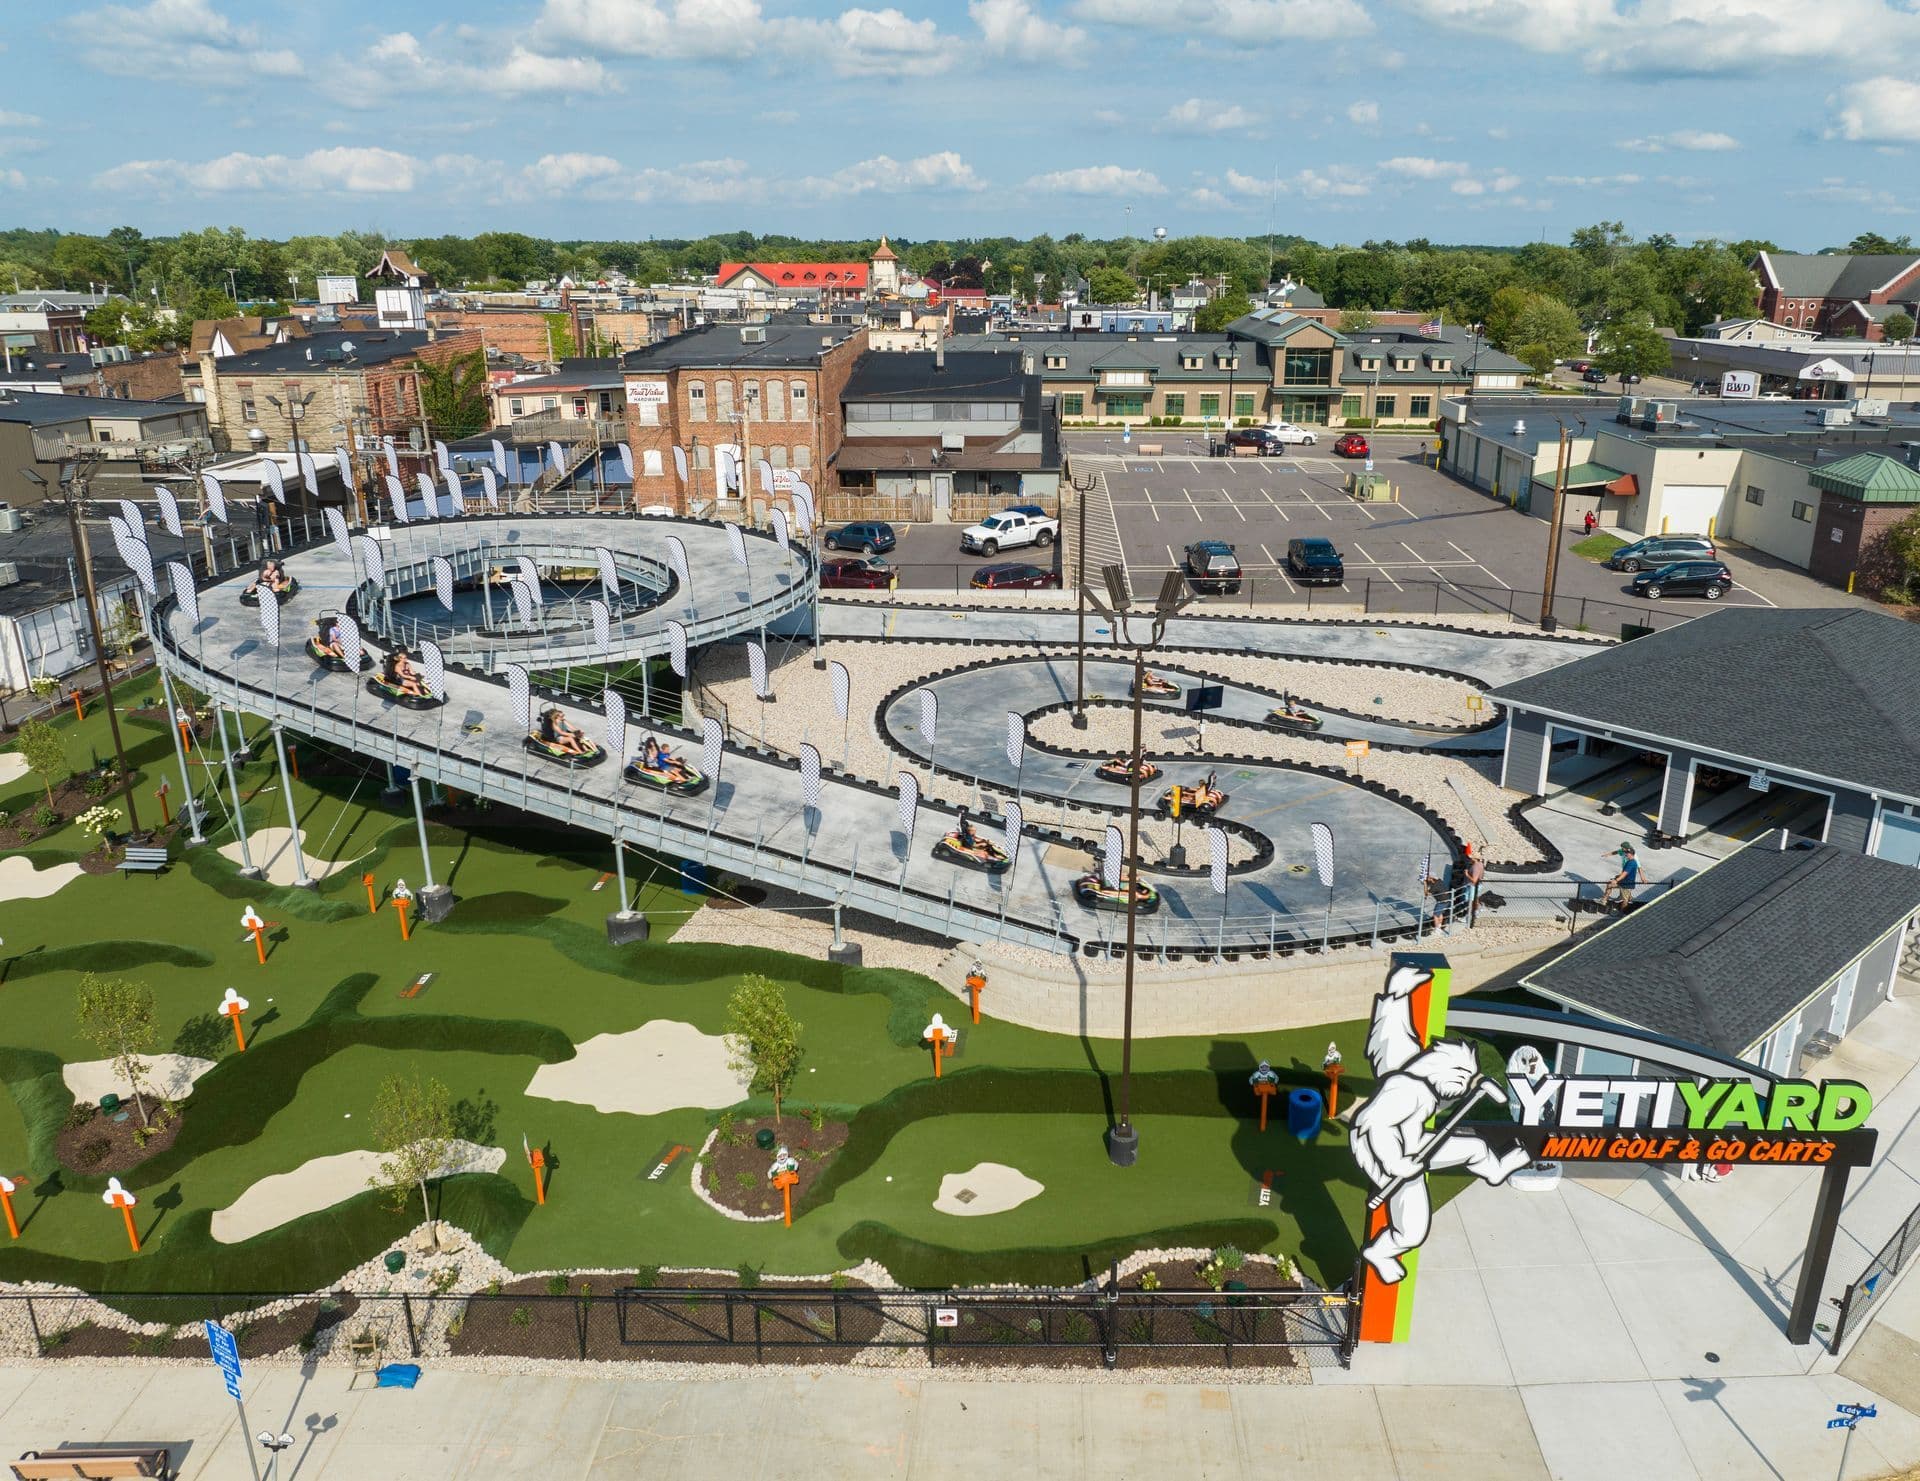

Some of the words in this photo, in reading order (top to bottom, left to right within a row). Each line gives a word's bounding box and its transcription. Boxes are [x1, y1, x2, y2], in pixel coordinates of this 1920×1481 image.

[1726, 383, 1751, 392] BWD
[1541, 1137, 1607, 1158] MINI
[1608, 1138, 1680, 1160] GOLF
[1678, 1139, 1701, 1161] &
[1706, 1140, 1747, 1161] GO
[1748, 1141, 1837, 1163] CARTS
[1842, 1406, 1862, 1416] Eddy
